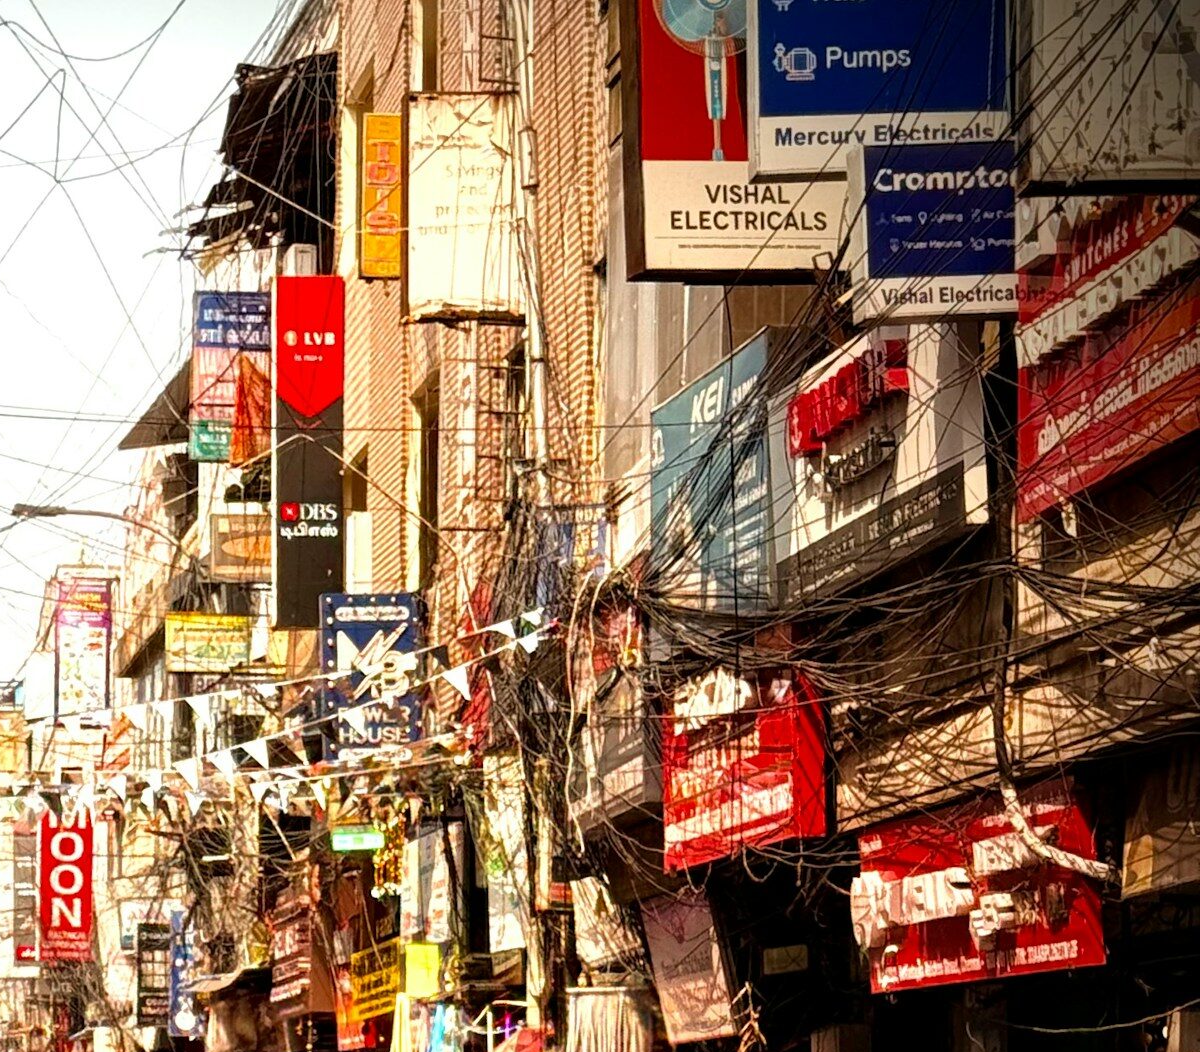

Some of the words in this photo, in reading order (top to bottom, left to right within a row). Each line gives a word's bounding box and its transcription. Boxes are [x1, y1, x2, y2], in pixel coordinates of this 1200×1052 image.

[825, 46, 912, 73] Pumps
[774, 126, 867, 147] Mercury
[874, 122, 995, 142] Electricals
[872, 167, 1016, 195] Crompto
[704, 184, 791, 205] VISHAL
[670, 211, 828, 232] ELECTRICALS
[881, 286, 933, 304] Vishal
[304, 332, 336, 346] LVB
[689, 376, 725, 434] KEI
[300, 503, 338, 520] DBS
[48, 804, 87, 928] MOON
